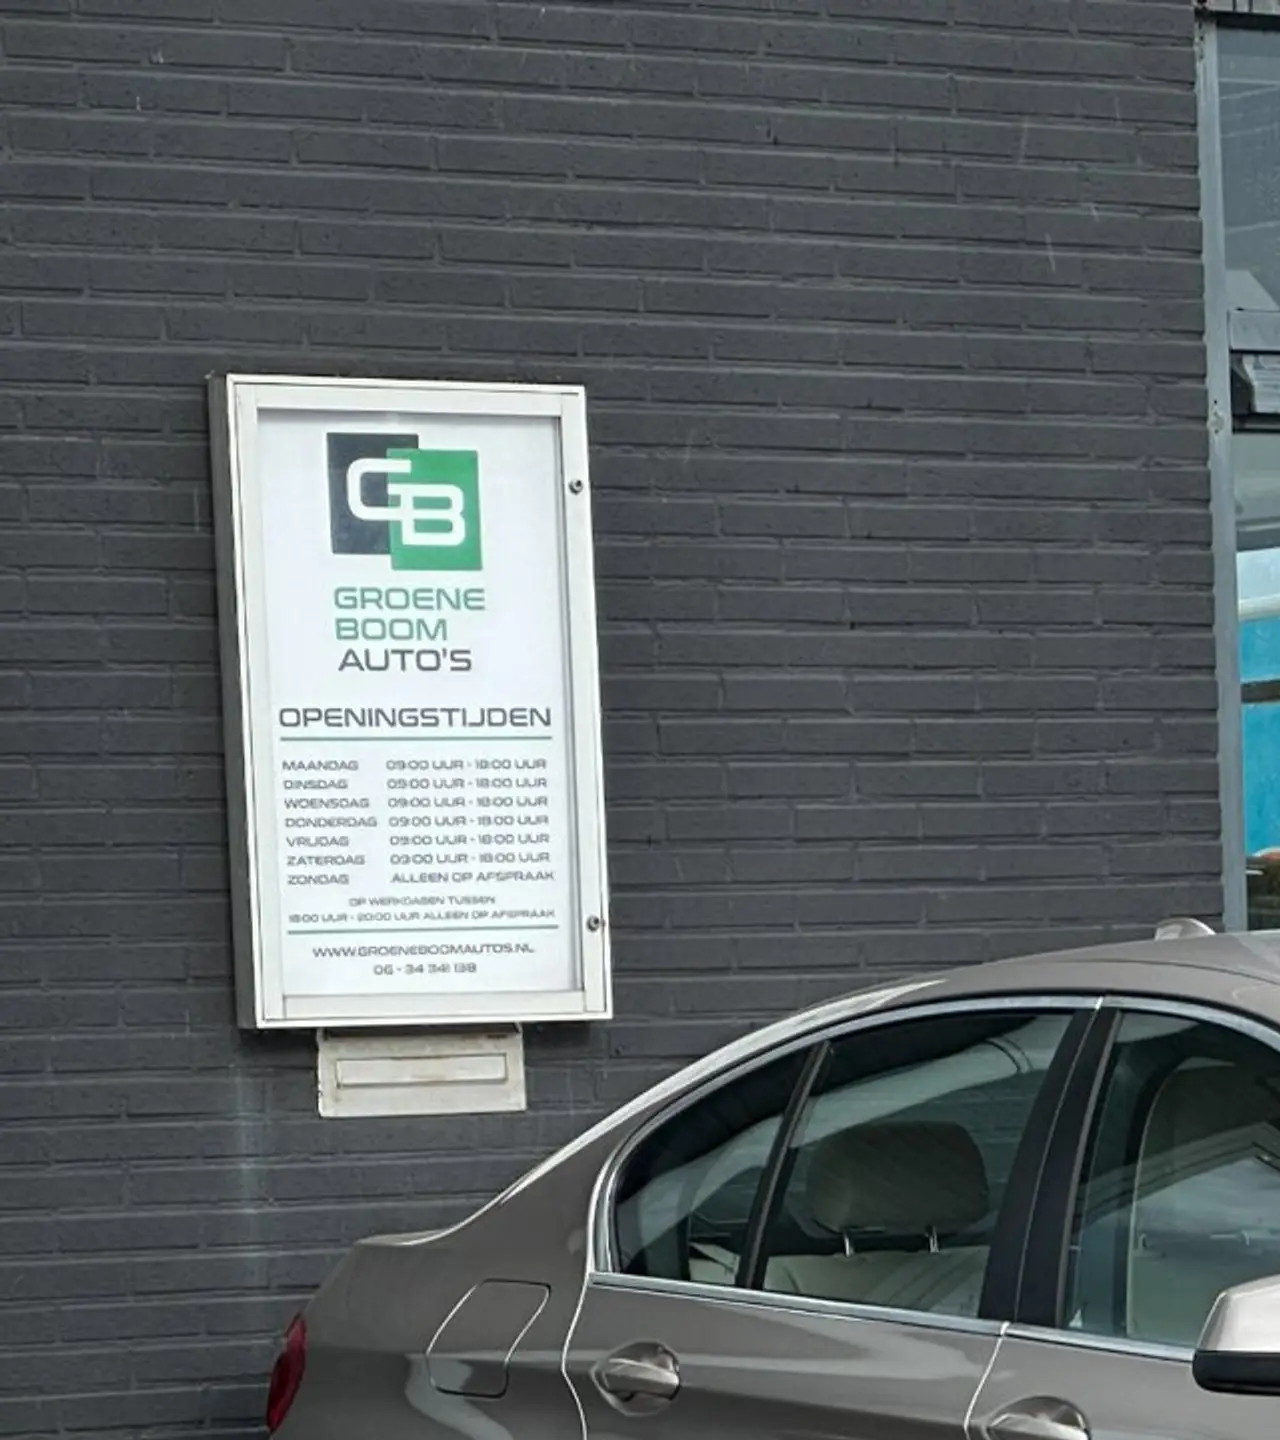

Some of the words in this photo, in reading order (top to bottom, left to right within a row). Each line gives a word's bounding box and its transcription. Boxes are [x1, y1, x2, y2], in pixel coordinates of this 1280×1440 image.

[334, 587, 485, 611] GROENE
[335, 618, 447, 641] BOOM
[338, 648, 471, 671] AUTO'S
[279, 708, 551, 727] OPENINGSTIJDEN
[282, 760, 359, 771] MAANDAG
[432, 760, 463, 770] UUR
[515, 759, 546, 769] UUR
[283, 779, 348, 790] DINSDAG
[433, 778, 465, 789] UUR
[516, 778, 547, 788] UUR
[284, 798, 370, 809] WOENSDAG
[434, 797, 465, 807] UUR
[516, 796, 548, 807] UUR
[285, 817, 377, 828] DONDERDAG
[435, 816, 466, 826] UUR
[517, 815, 549, 825] UUR
[286, 836, 349, 847] VRIJDAG
[435, 835, 467, 845] UUR
[518, 833, 550, 844] UUR
[287, 855, 365, 866] ZATERDAG
[436, 854, 468, 864] UUR
[518, 852, 550, 863] UUR
[287, 874, 349, 885] ZONDAG
[391, 872, 449, 883] ALLEEN
[476, 871, 554, 881] AFSPRAAK
